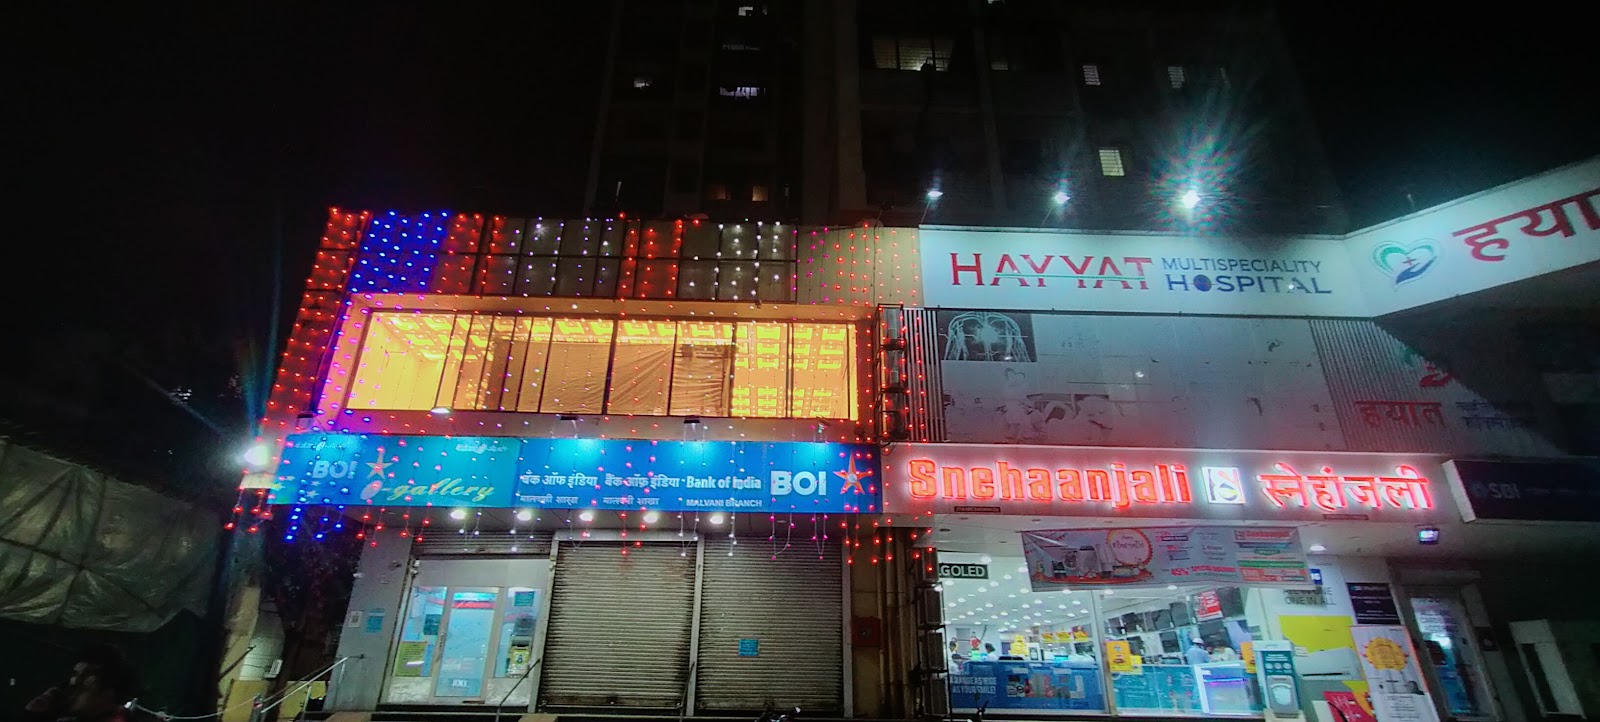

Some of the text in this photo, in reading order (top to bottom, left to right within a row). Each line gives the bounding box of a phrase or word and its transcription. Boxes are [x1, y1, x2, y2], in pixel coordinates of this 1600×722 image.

[950, 253, 1154, 290] HAYYAT
[1161, 257, 1321, 274] MULTISPECIALITY
[1165, 274, 1332, 295] HOSPITAL
[567, 472, 598, 489] इंडिया
[650, 473, 680, 490] इंडिया
[686, 476, 762, 490] Bank of India
[770, 470, 827, 496] BOI
[907, 458, 1192, 509] Snehaanjali
[1256, 461, 1434, 512] स्नेहांजली
[686, 498, 763, 508] MALVANI BRANCH
[939, 564, 986, 578] GOLED
